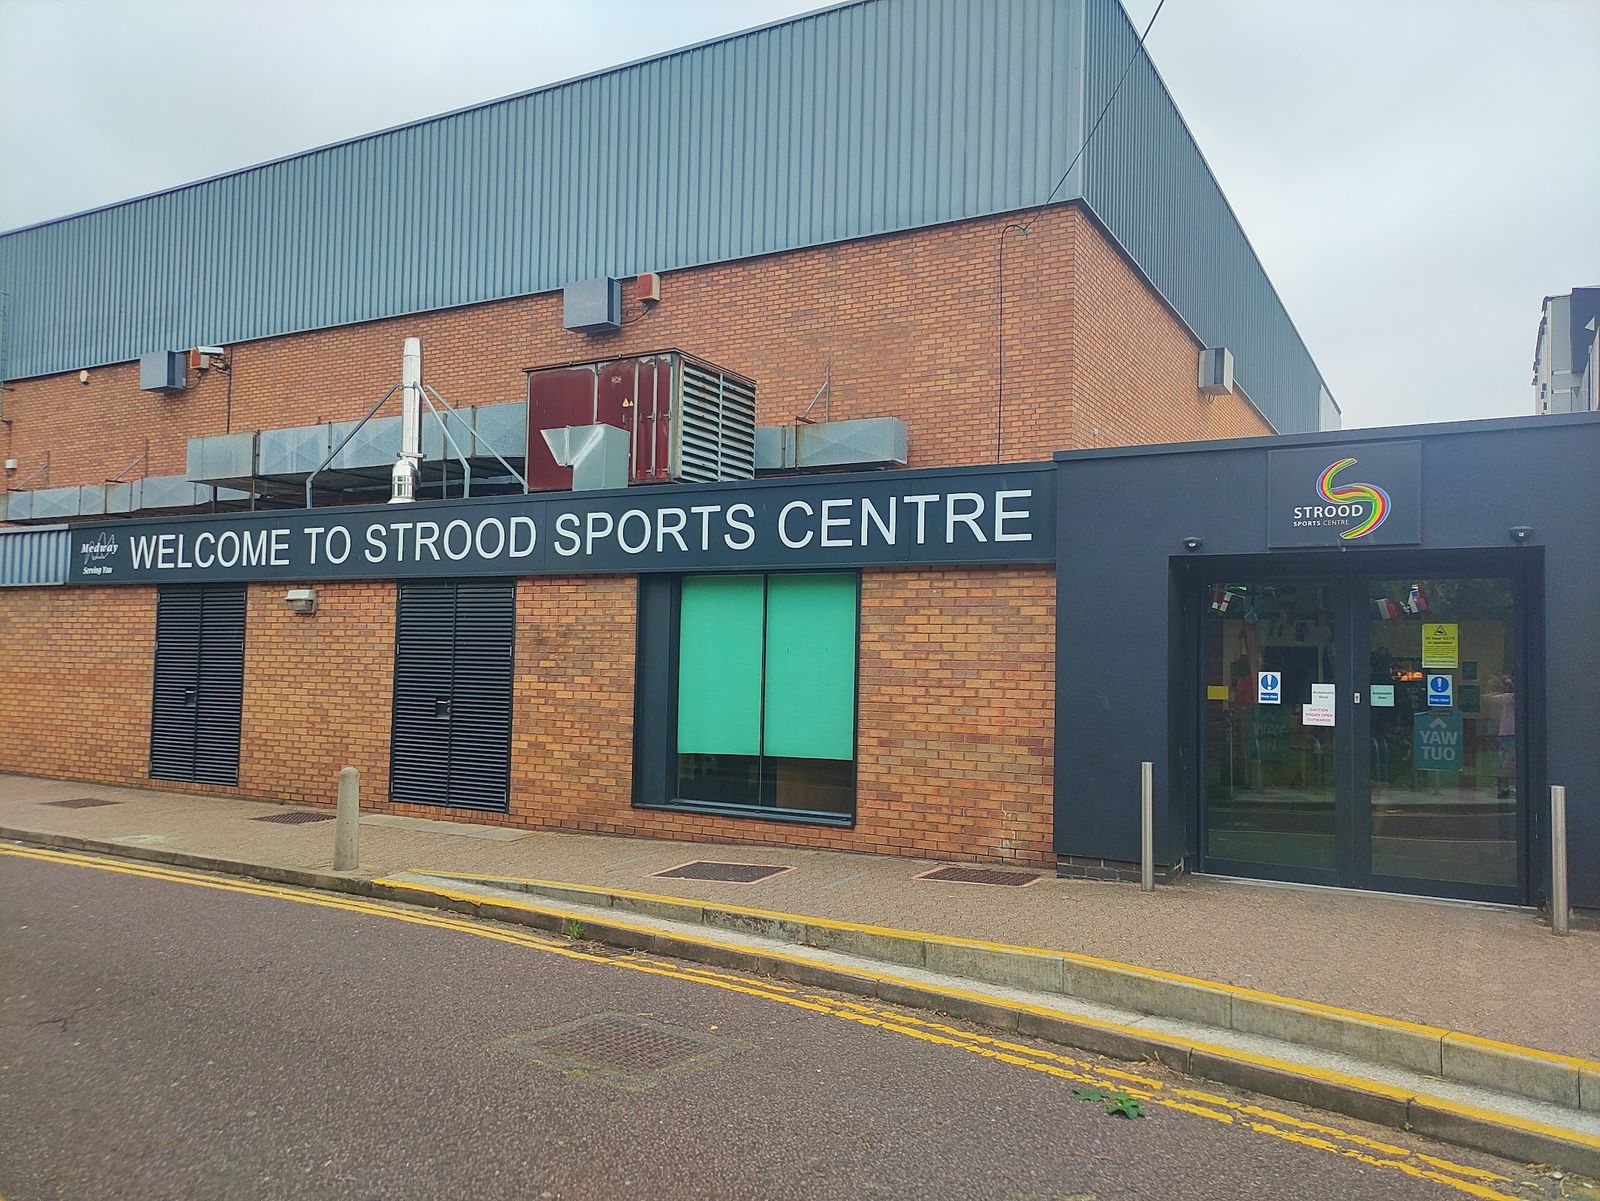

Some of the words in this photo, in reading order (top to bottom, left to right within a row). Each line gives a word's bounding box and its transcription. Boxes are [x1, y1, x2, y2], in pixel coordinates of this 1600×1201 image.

[1293, 504, 1364, 519] STROOD
[130, 529, 290, 570] WELCOME
[304, 525, 351, 564] TO
[364, 516, 537, 562] STROOD
[554, 503, 756, 557] SPORTS
[778, 489, 1033, 549] CENTRE
[81, 543, 119, 554] Medway
[83, 566, 102, 575] Serving
